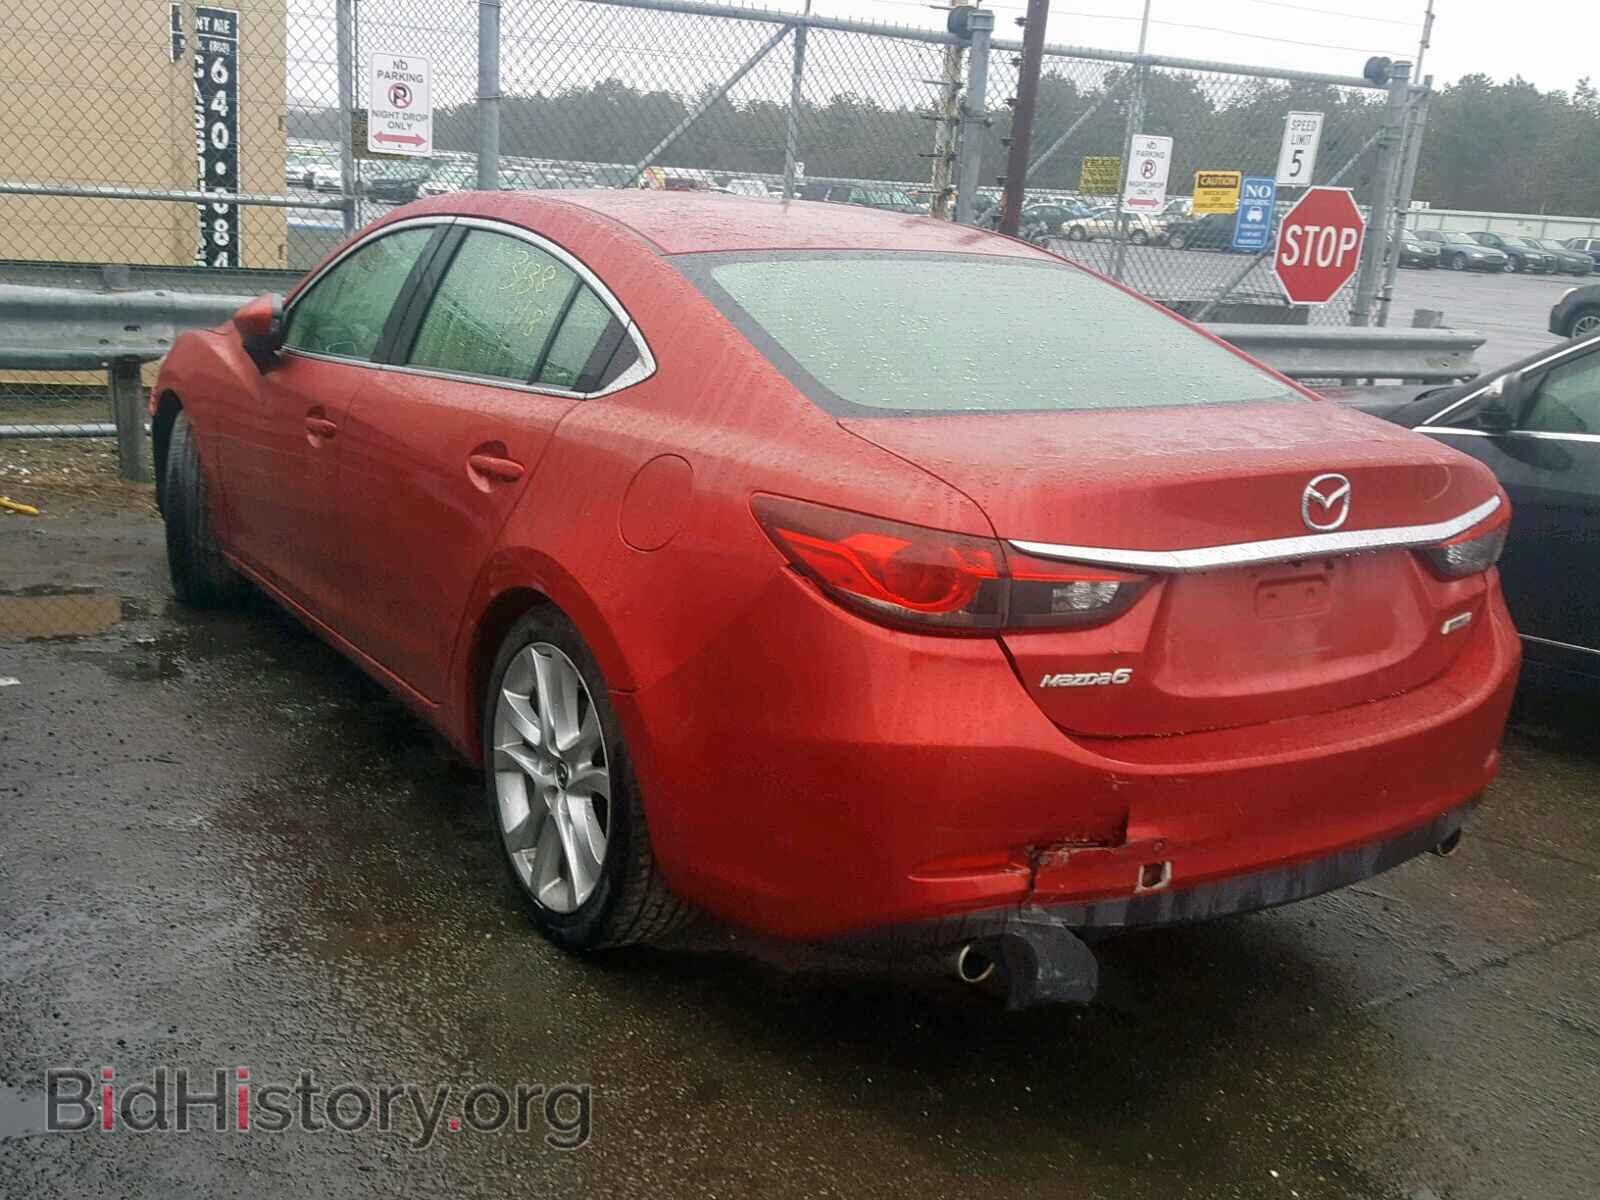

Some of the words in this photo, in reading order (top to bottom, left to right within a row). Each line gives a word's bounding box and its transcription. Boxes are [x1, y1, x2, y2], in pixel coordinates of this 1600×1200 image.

[392, 60, 408, 71] NO
[377, 70, 424, 84] PARKING
[371, 110, 400, 120] NIGHT
[402, 112, 429, 122] DROP
[387, 120, 414, 131] ONLY
[1291, 119, 1318, 132] SPEED
[1290, 134, 1313, 146] LIMIT
[1289, 149, 1304, 178] 5
[1200, 175, 1237, 187] CAUTION
[1244, 184, 1272, 199] NO
[1281, 223, 1358, 268] STOP
